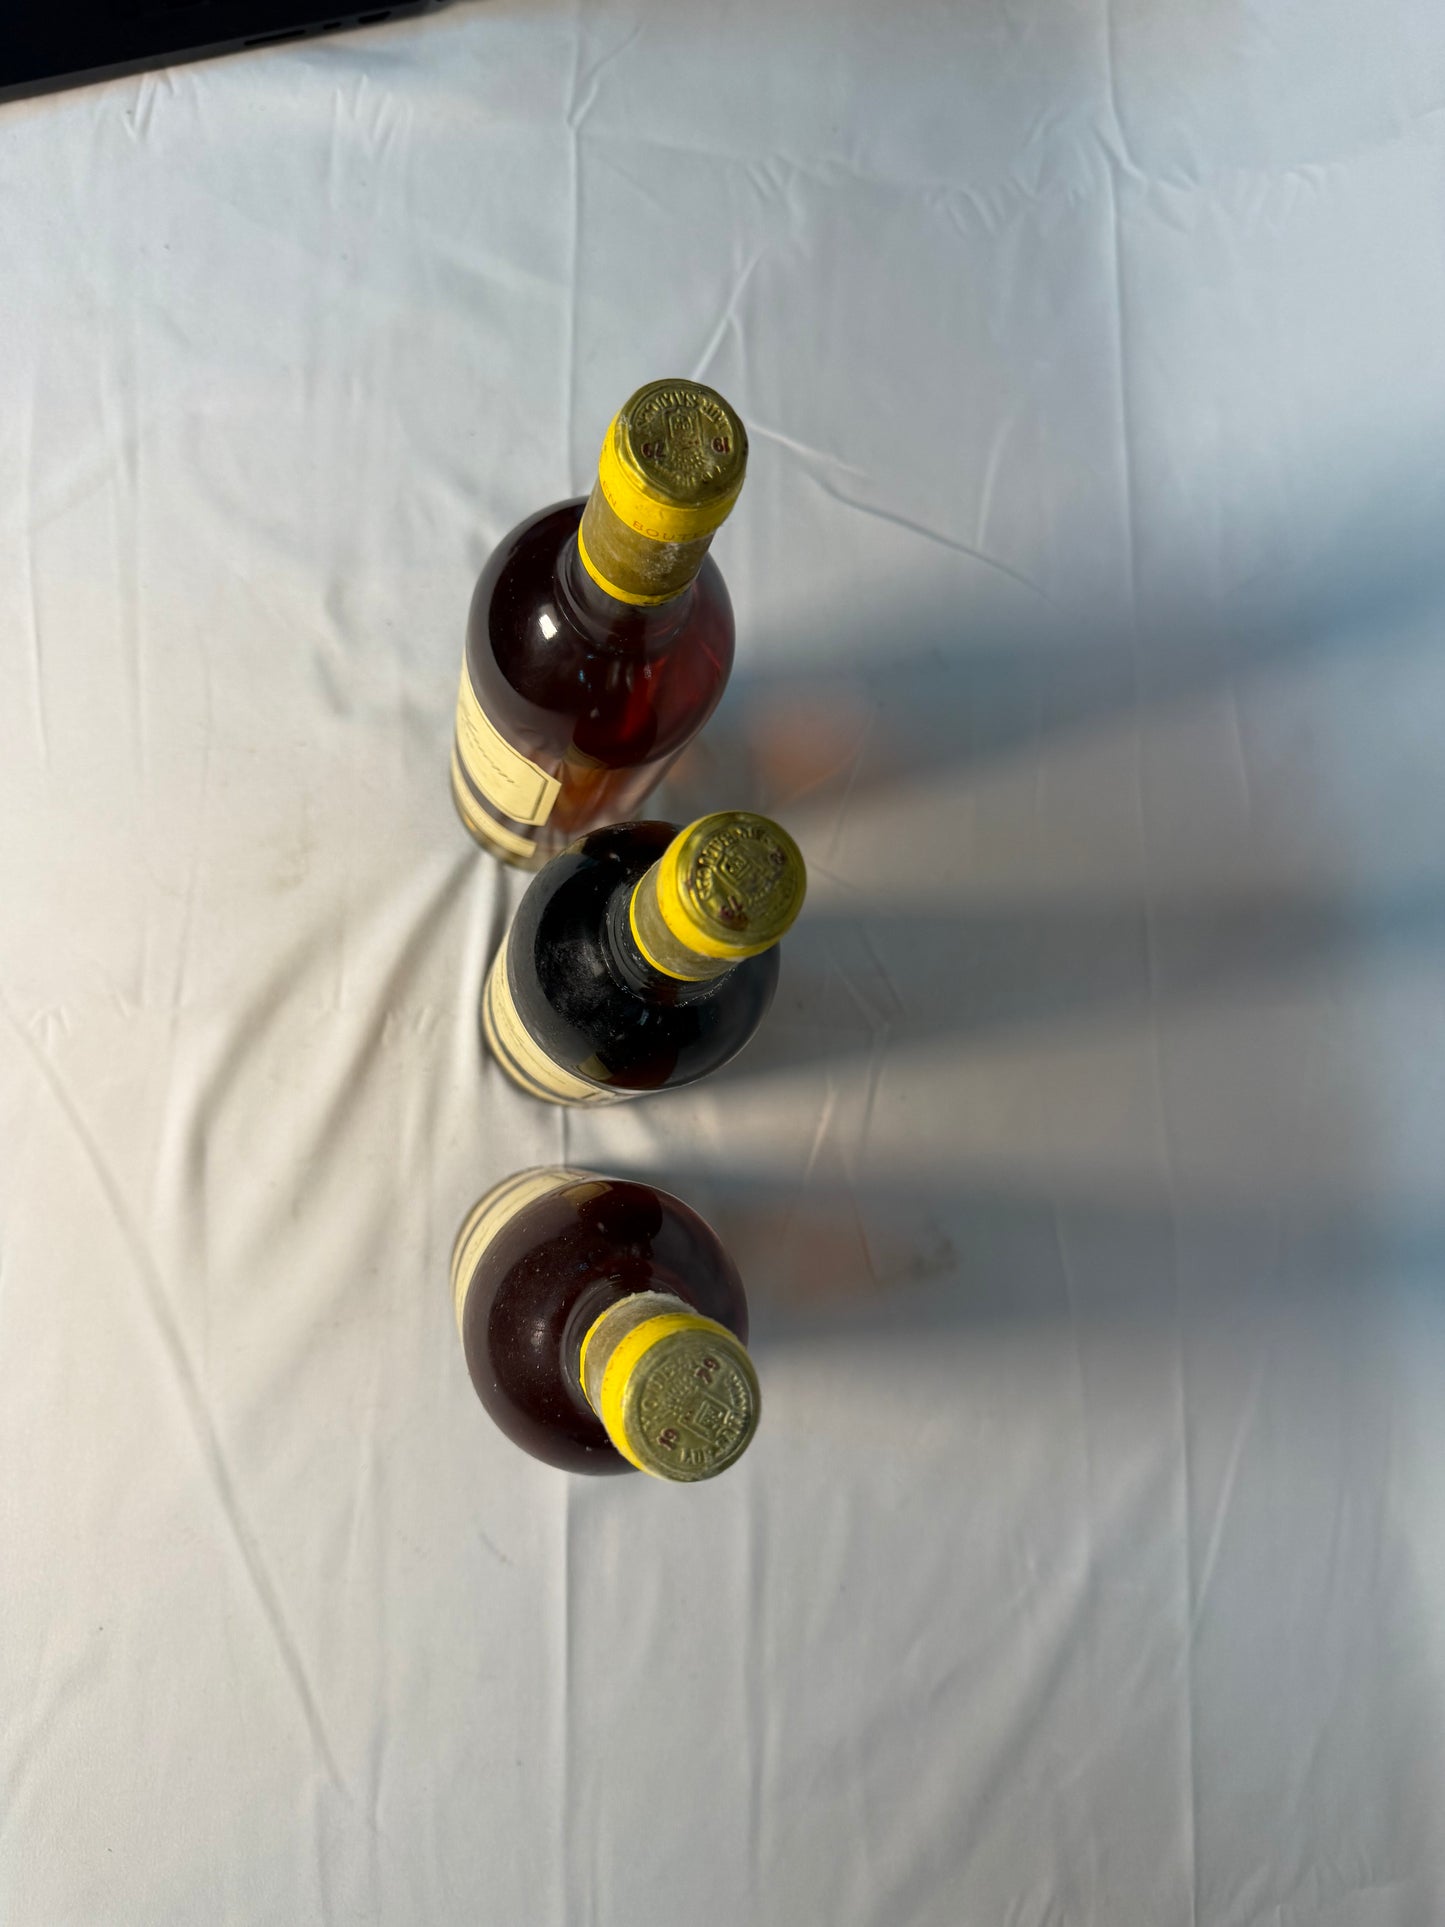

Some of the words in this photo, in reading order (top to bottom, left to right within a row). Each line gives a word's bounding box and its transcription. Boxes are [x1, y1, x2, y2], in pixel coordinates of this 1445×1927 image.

[711, 436, 731, 454] 19
[656, 1428, 679, 1451] 19
[694, 1355, 721, 1385] 79
